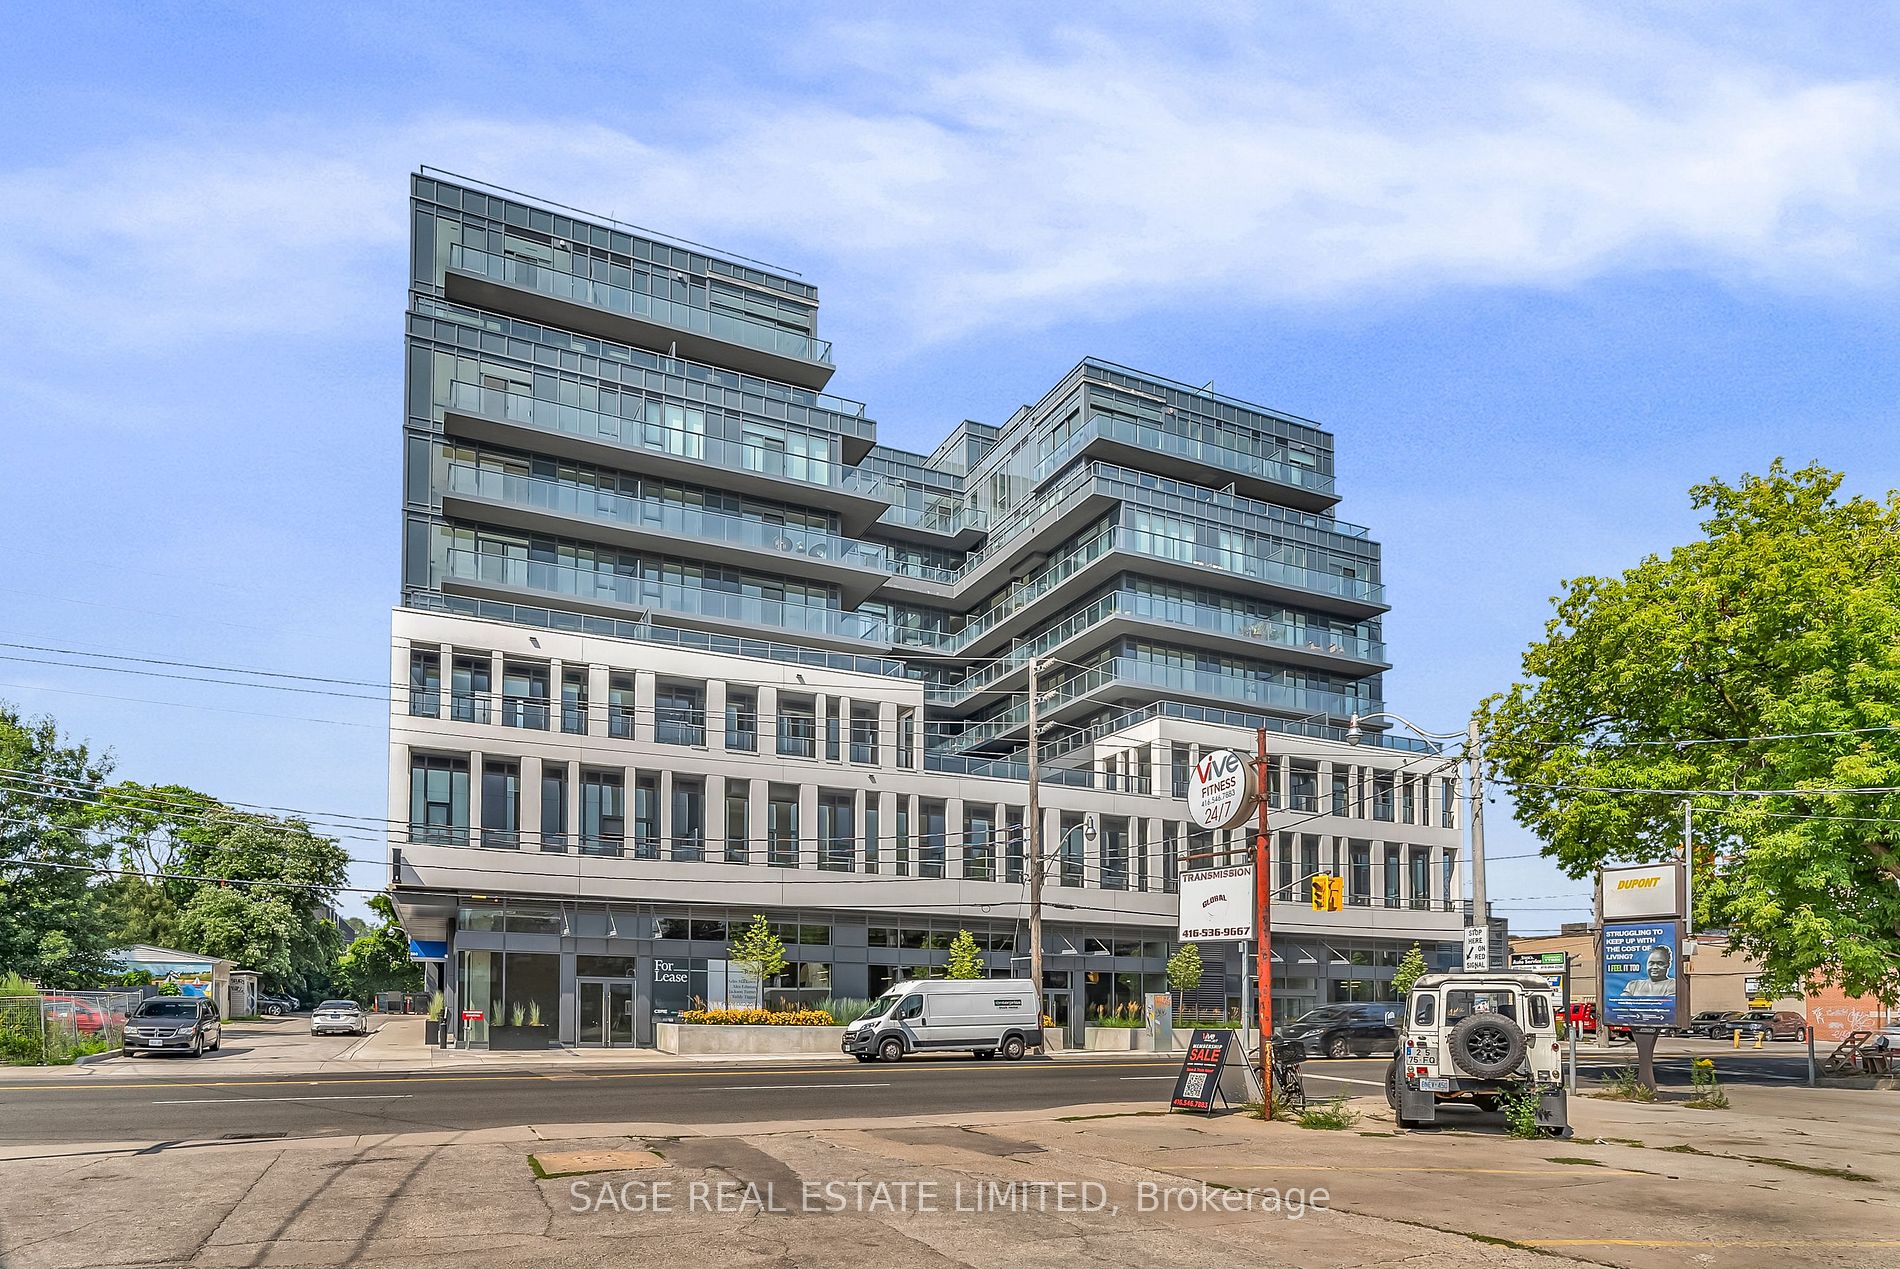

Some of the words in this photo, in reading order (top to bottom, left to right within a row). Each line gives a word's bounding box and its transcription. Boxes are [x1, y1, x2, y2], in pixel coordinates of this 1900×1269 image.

[1202, 776, 1236, 798] FITNESS
[1205, 800, 1232, 825] 24/7
[1182, 867, 1251, 882] TRANSMISSION
[1617, 877, 1660, 890] DUPONT
[1202, 894, 1227, 908] GLOBAL
[1183, 926, 1250, 938] 416-536-9667
[654, 960, 674, 971] For
[1630, 964, 1640, 972] TOO
[654, 971, 688, 982] Lease
[1189, 1048, 1221, 1062] SALE
